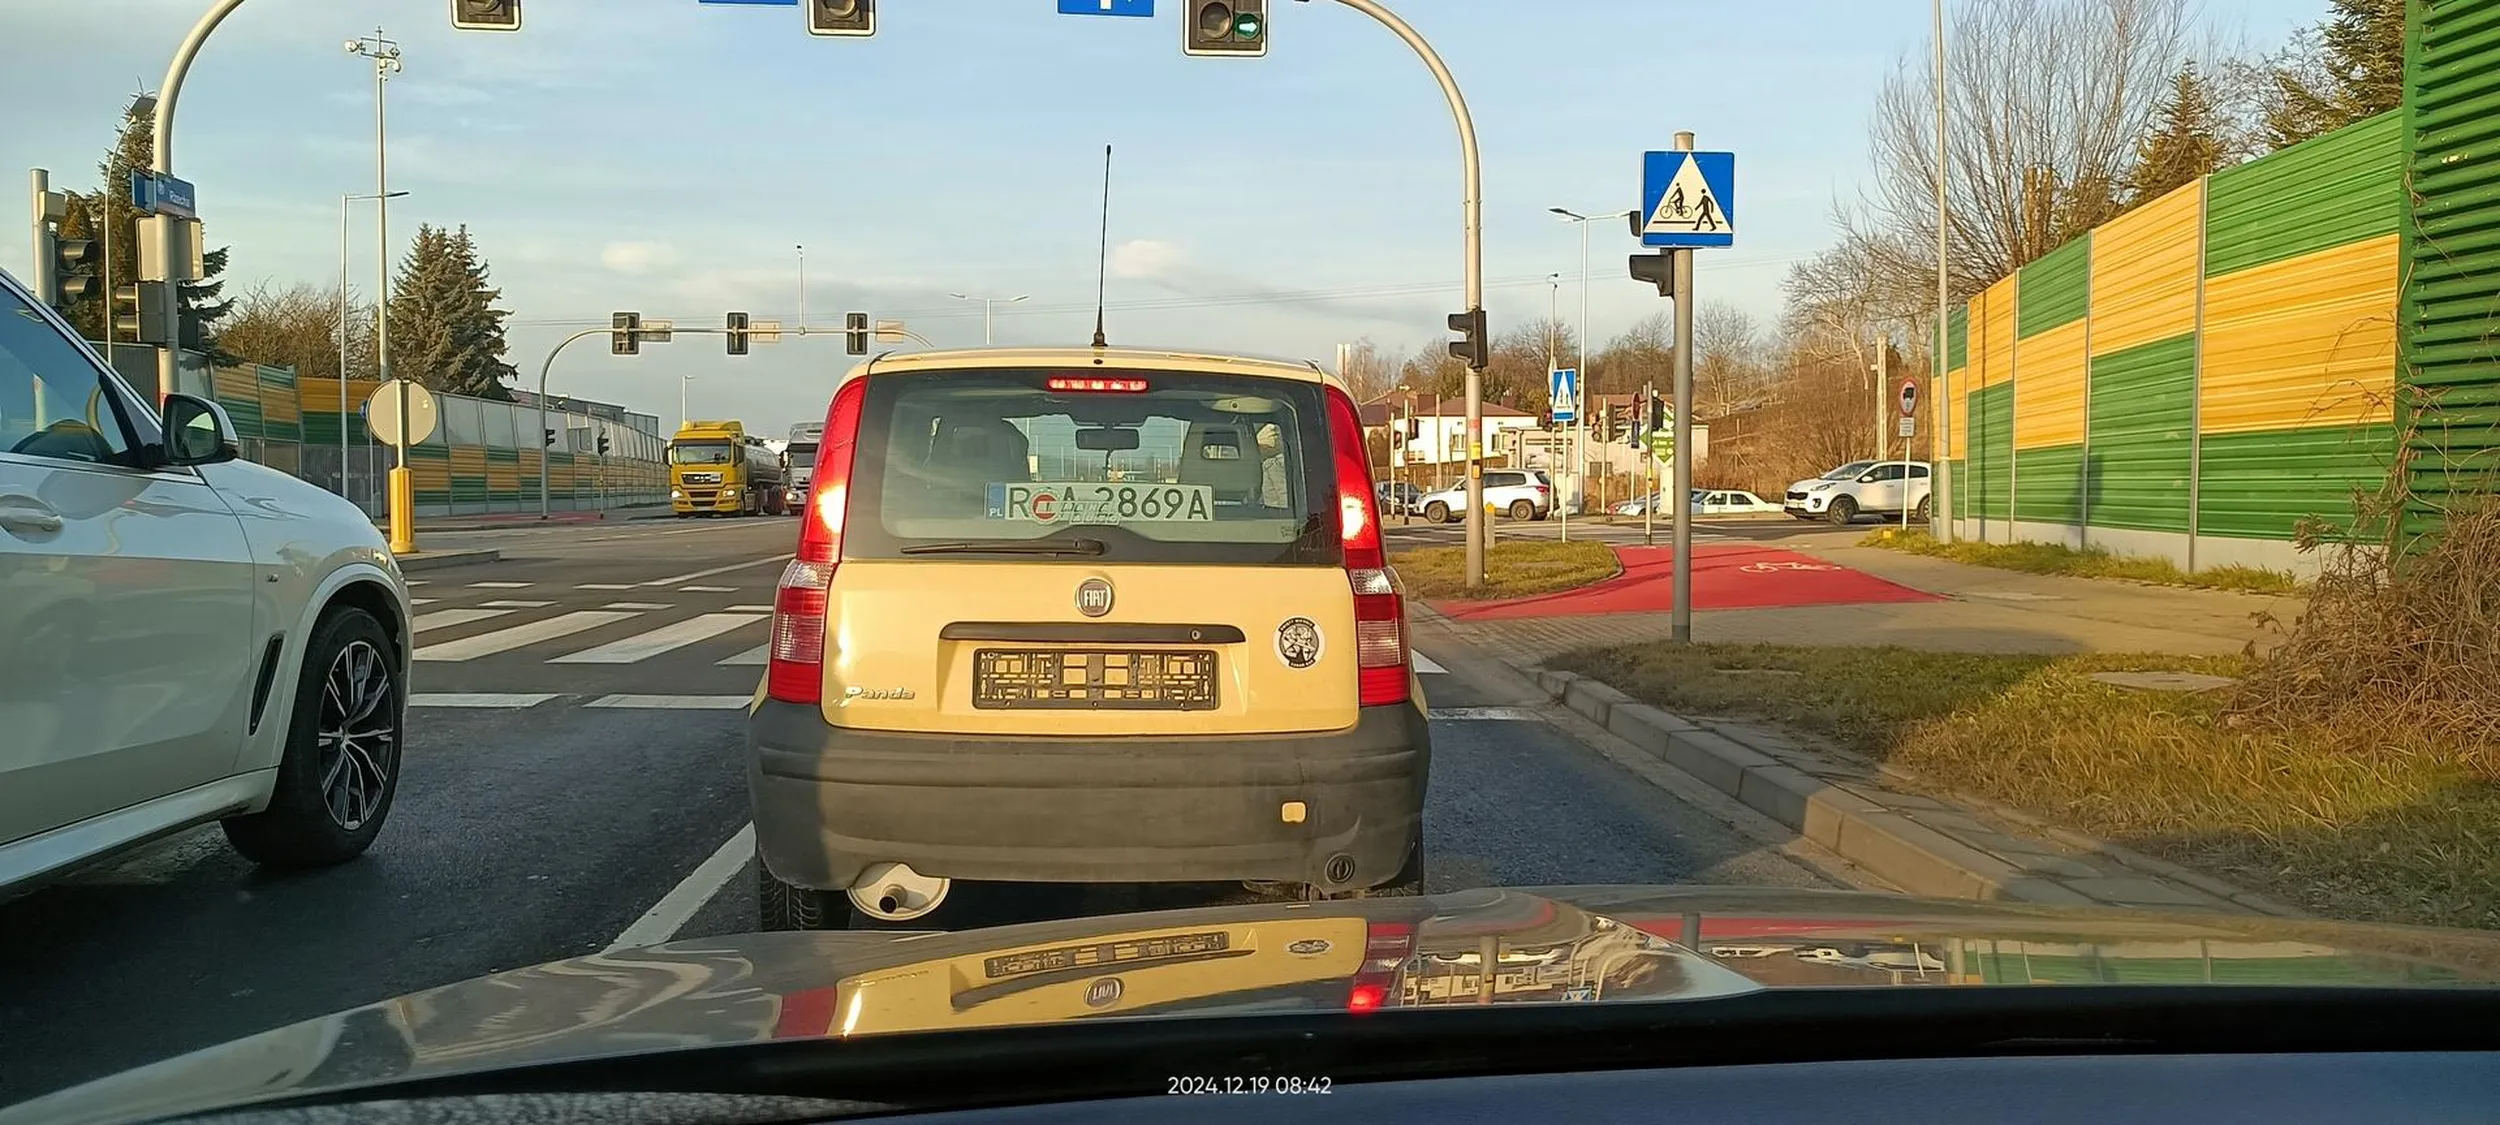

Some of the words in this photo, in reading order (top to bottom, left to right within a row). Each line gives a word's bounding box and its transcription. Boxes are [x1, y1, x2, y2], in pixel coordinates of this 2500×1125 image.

[1094, 486, 1209, 520] 2869A
[989, 508, 1003, 517] PL
[1084, 590, 1106, 607] FIAT
[845, 686, 916, 700] Panda
